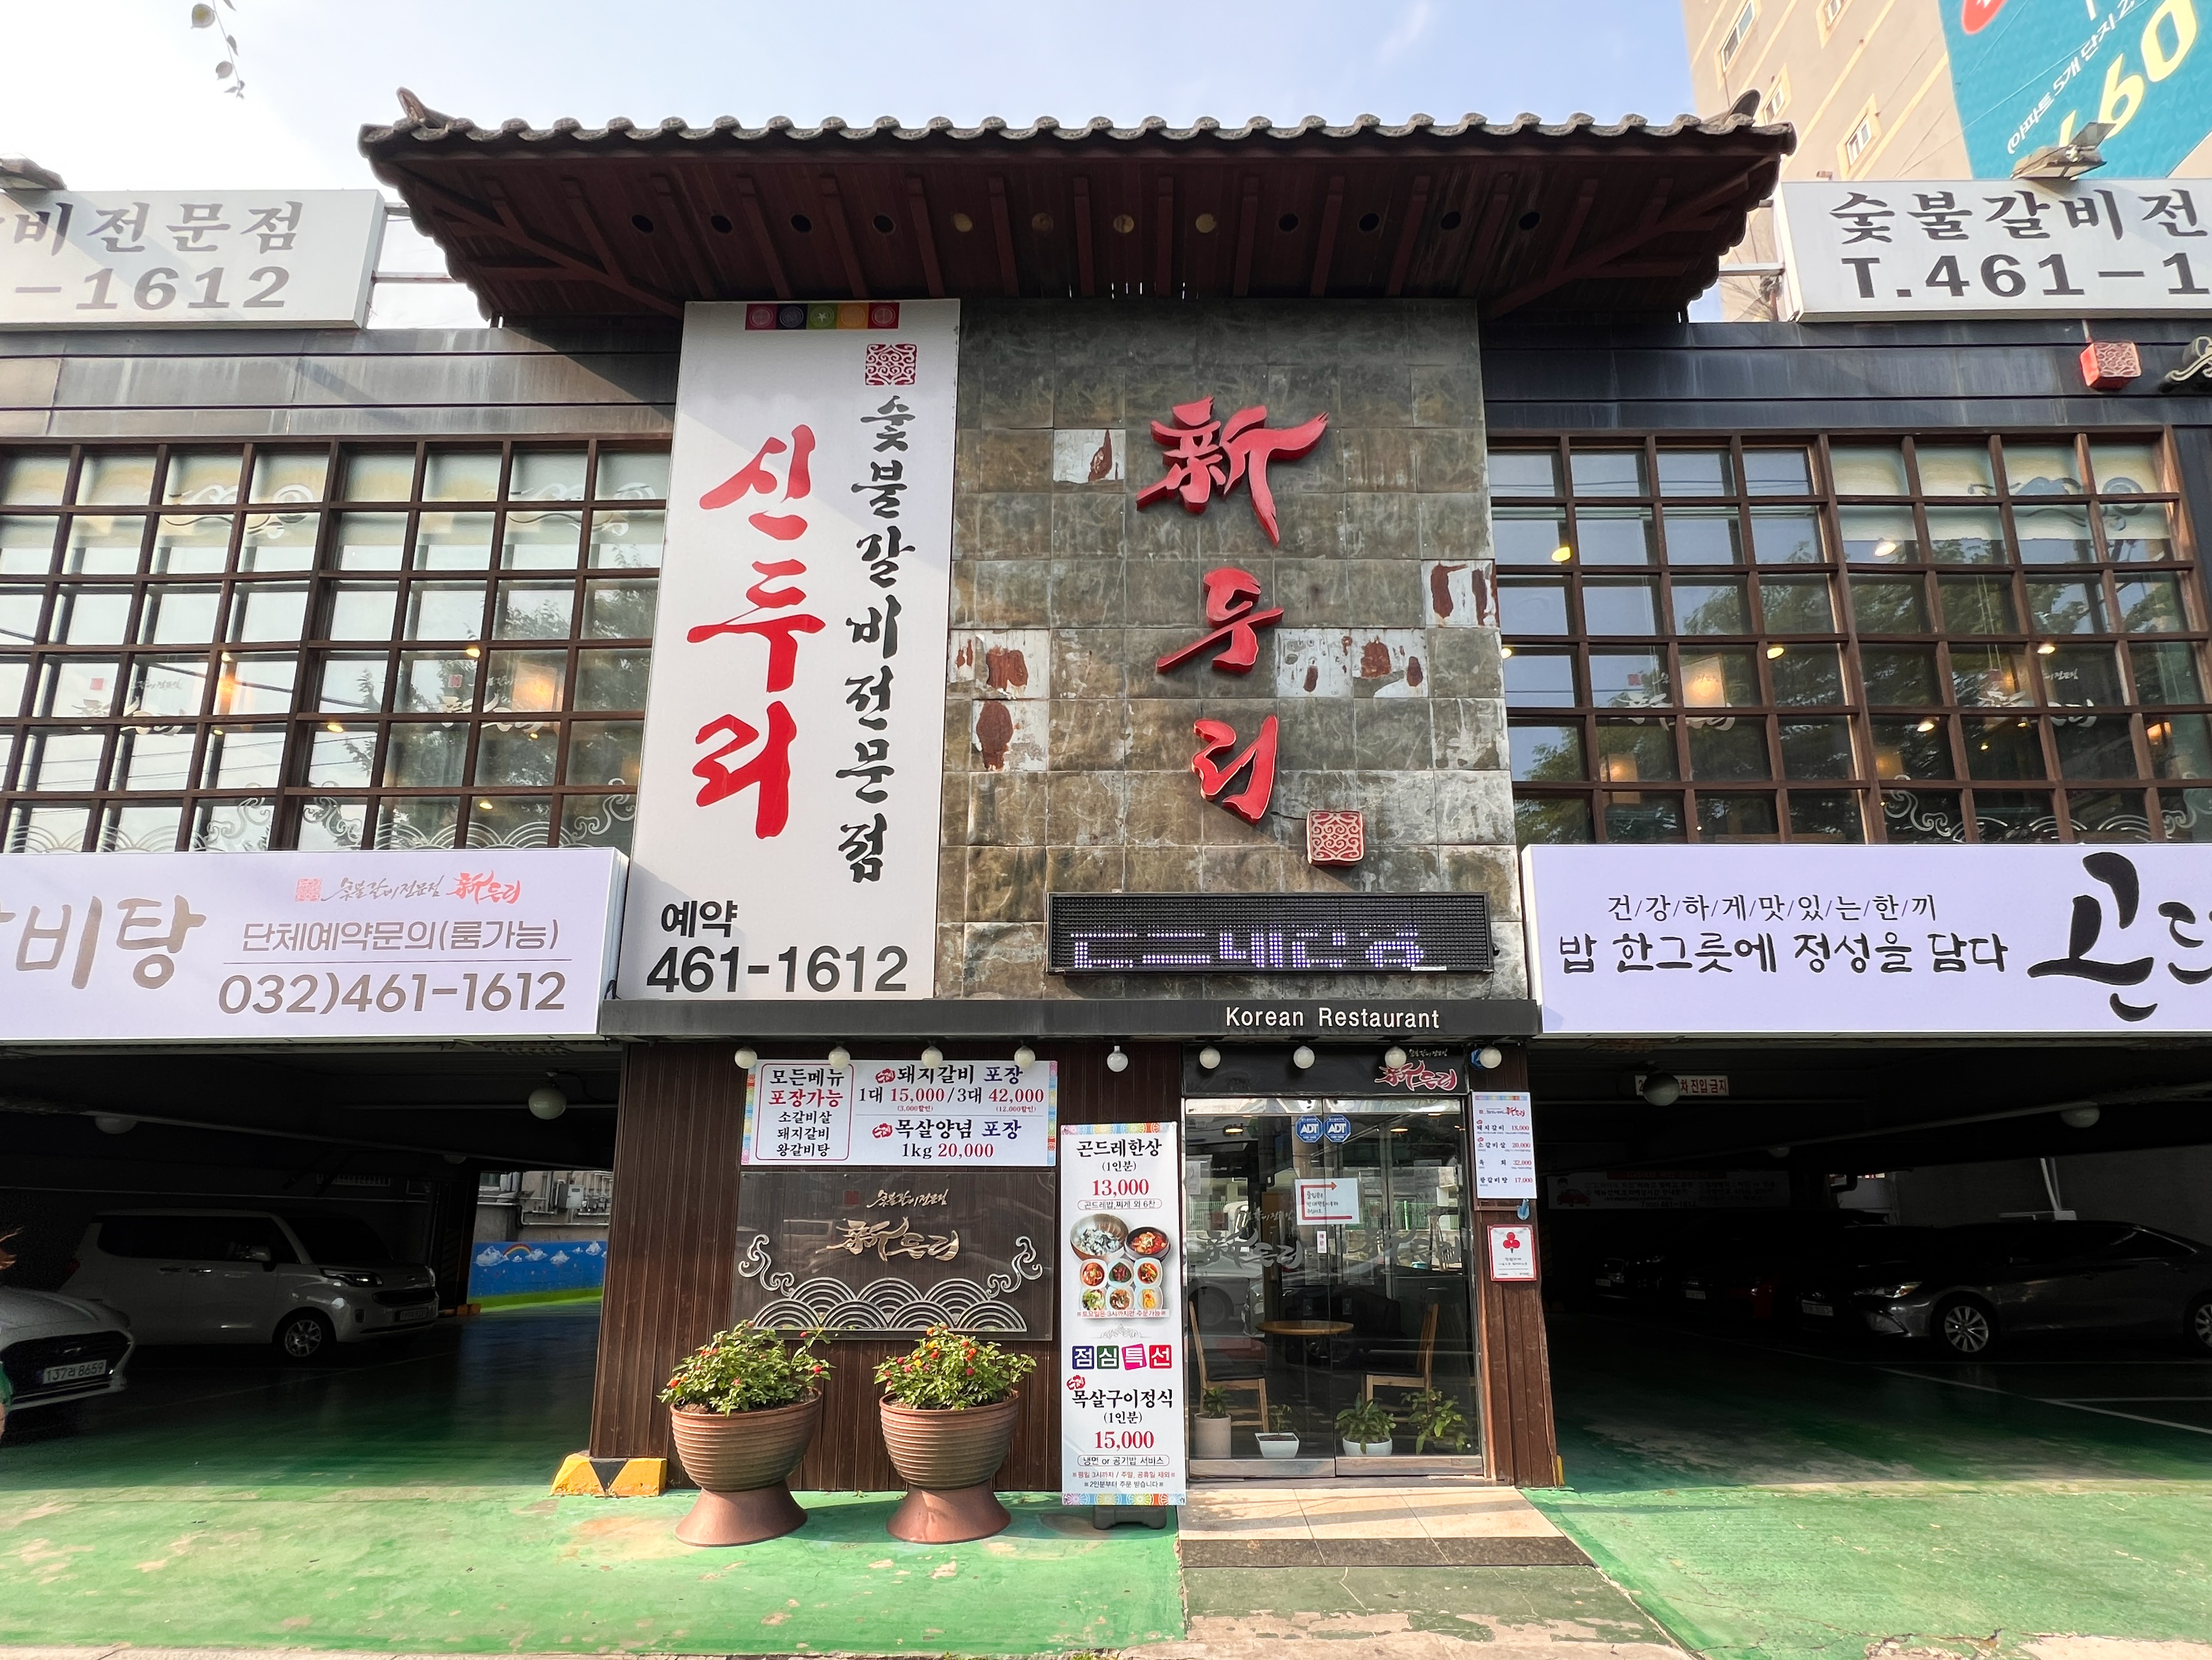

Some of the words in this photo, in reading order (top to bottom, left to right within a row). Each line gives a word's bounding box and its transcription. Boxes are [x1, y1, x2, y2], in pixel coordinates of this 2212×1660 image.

[2053, 57, 2082, 96] 5개
[2082, 13, 2116, 62] 단지
[1829, 189, 2210, 245] 숯불갈비전
[0, 201, 303, 256] 비전문점
[686, 423, 827, 840] 신두리
[835, 395, 917, 884] 숯불갈비전문점
[661, 900, 738, 938] 예약
[0, 894, 206, 991] 비탕
[242, 919, 560, 953] 단체예약문의(룸가능)
[1559, 934, 1594, 974] 밥
[1612, 933, 1778, 974] 한그릇에
[1794, 932, 1913, 974] 정성을
[1931, 932, 2009, 974] 담다
[646, 945, 908, 994] 461-1612
[218, 970, 566, 1016] 032)461-1612
[1225, 1006, 1305, 1027] Korean
[1318, 1006, 1440, 1029] Restaurant
[770, 1068, 844, 1087] 모든메뉴
[897, 1064, 974, 1085] 돼지갈비
[983, 1066, 1023, 1085] 포장
[768, 1088, 843, 1107] 포장가능
[859, 1087, 883, 1104] 1대
[989, 1088, 1044, 1104] 42,000
[778, 1110, 832, 1124] 소갈비살
[777, 1127, 830, 1140] 돼지갈비
[895, 1119, 972, 1139] 목살양념
[982, 1119, 1022, 1140] 포장
[1300, 1123, 1319, 1134] ADT
[1327, 1123, 1347, 1134] ADT
[776, 1143, 831, 1157] 왕갈비탕
[902, 1143, 932, 1160] 1kg
[938, 1143, 994, 1160] 20,000
[1077, 1138, 1162, 1158] 곤드레한상
[1102, 1161, 1137, 1172] (1인분)
[1092, 1179, 1149, 1197] 13,000
[1074, 1346, 1172, 1368] 점심특선
[78, 1361, 104, 1376] 8659
[1071, 1389, 1173, 1409] 목살구이정식
[1104, 1412, 1143, 1424] (1인분)
[1095, 1431, 1154, 1451] 15,000
[1083, 1456, 1099, 1465] 냉면
[1113, 1456, 1137, 1466] 공기밥
[1140, 1455, 1165, 1465] 서비스
